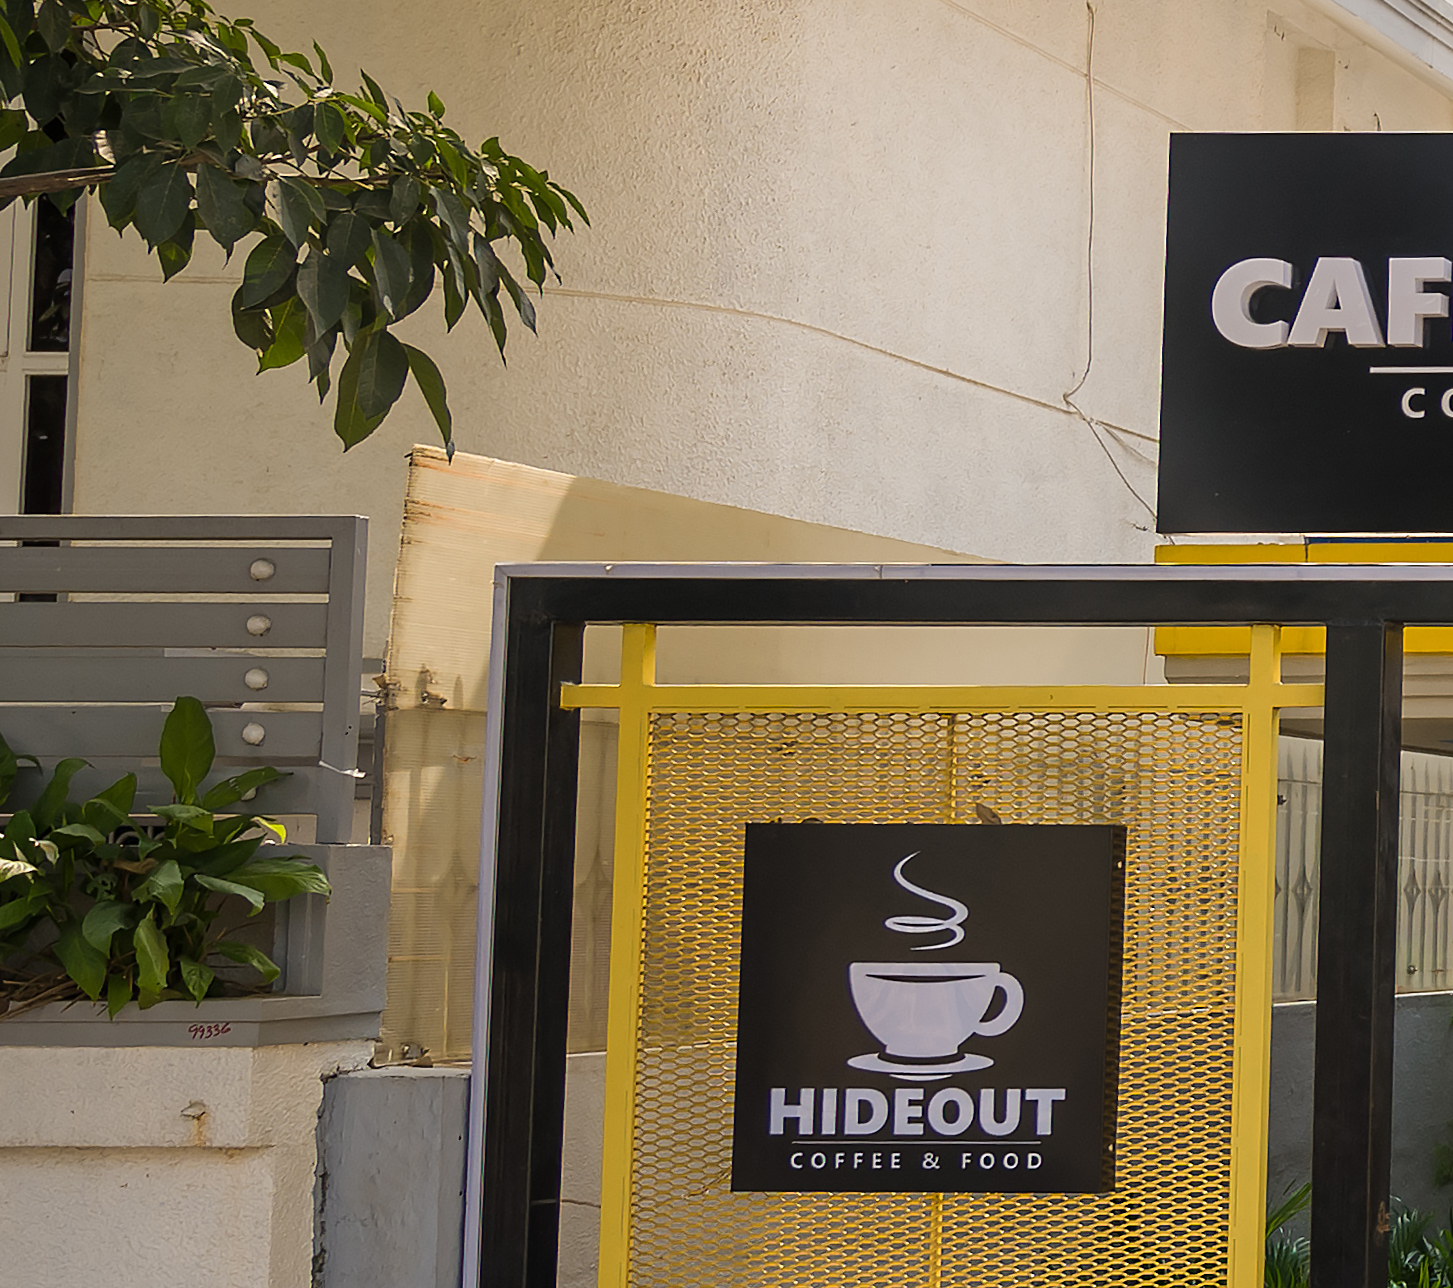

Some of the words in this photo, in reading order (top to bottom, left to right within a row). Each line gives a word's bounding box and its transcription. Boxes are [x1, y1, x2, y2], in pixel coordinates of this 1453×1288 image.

[768, 1086, 1067, 1137] HIDEOUT
[790, 1152, 902, 1171] COFFEE
[922, 1153, 941, 1171] &
[961, 1152, 1043, 1171] FOOD
